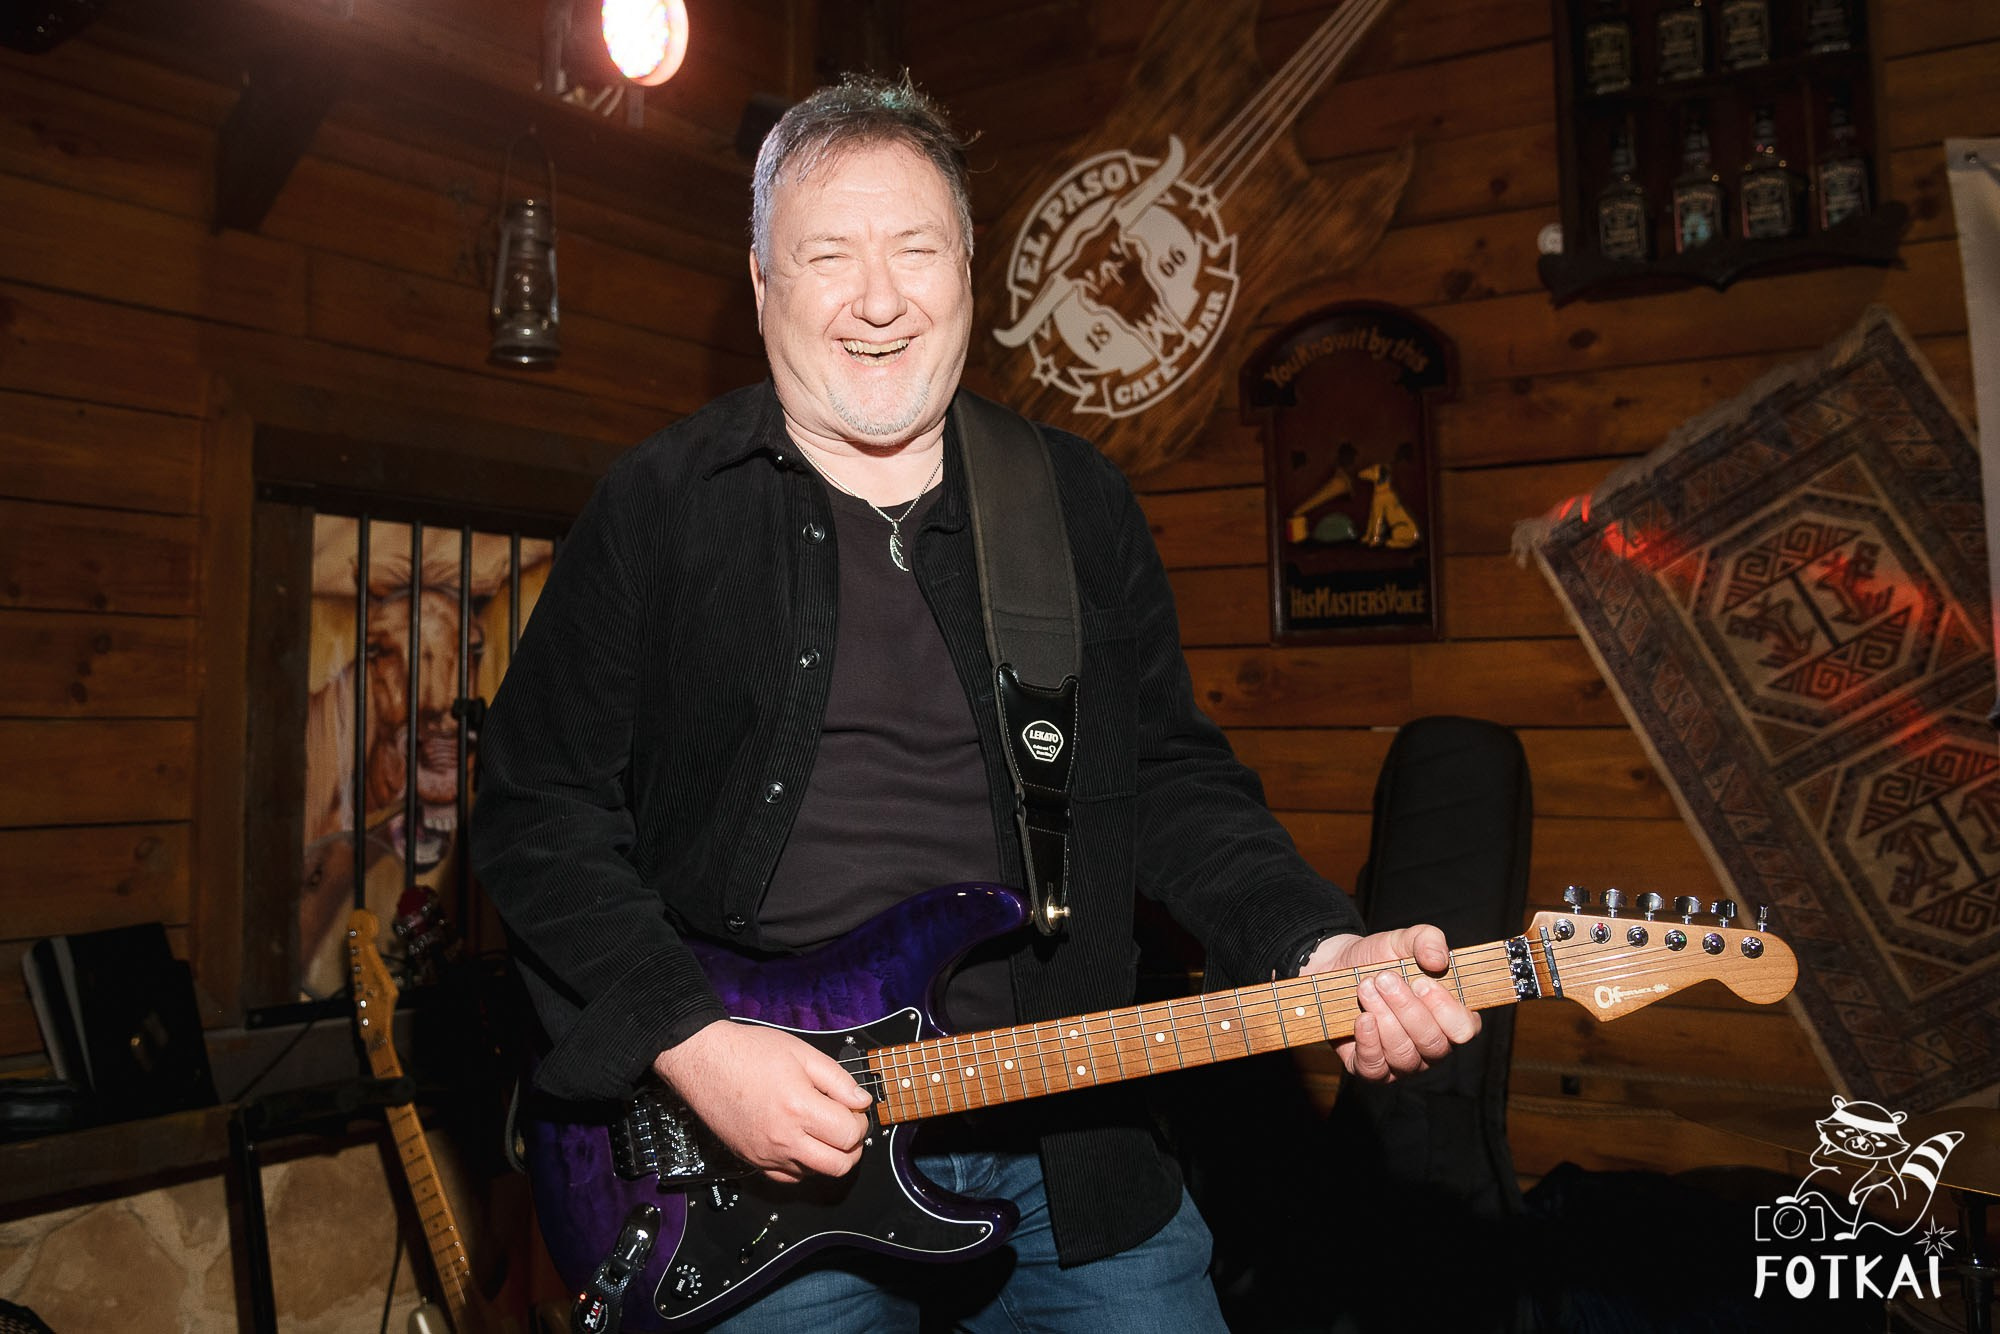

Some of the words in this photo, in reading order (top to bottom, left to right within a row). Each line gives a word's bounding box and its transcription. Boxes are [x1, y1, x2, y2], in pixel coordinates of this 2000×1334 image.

[1017, 233, 1049, 283] EL
[1043, 162, 1128, 232] PASO
[1085, 323, 1113, 353] 18
[1114, 364, 1178, 406] CAFE
[1190, 291, 1226, 348] BAR
[1029, 729, 1059, 744] LEKATO
